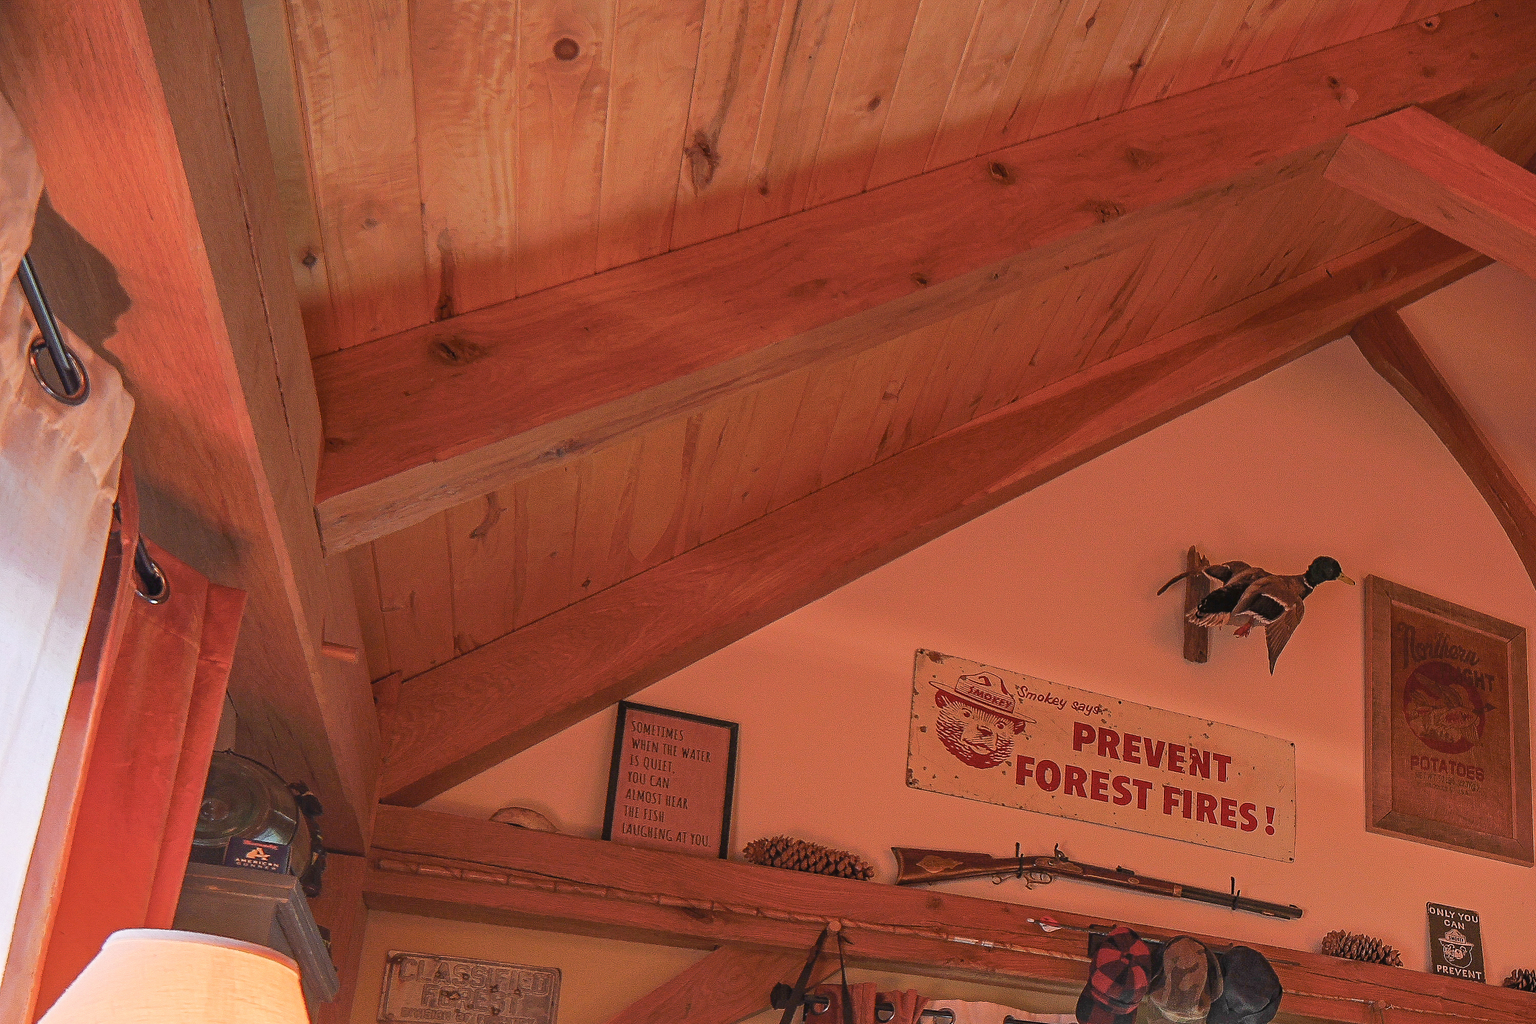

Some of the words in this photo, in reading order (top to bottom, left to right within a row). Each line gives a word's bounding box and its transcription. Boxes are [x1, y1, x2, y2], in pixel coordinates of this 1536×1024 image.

[968, 686, 1012, 709] SMOKEY
[1017, 685, 1067, 711] Smokey
[631, 720, 684, 741] SOMETIMES
[630, 754, 640, 767] IS
[632, 738, 659, 753] WHEN
[662, 743, 677, 757] THE
[682, 747, 711, 763] WATER
[1072, 721, 1232, 783] PREVENT
[1411, 755, 1485, 782] POTATOES
[628, 771, 646, 785] YOU
[650, 775, 670, 789] CAN
[1015, 754, 1153, 811] FOREST
[625, 788, 662, 805] ALMOST
[665, 795, 688, 809] HEAR
[624, 804, 639, 819] THE
[643, 808, 665, 823] FISH
[622, 822, 673, 842] LAUGHING
[676, 831, 687, 843] AT
[1429, 906, 1455, 918] ONLY
[1458, 912, 1479, 923] YOU
[1444, 919, 1465, 930] CAN
[398, 957, 550, 996] CLASSIFIED
[1436, 964, 1482, 980] PREVENT
